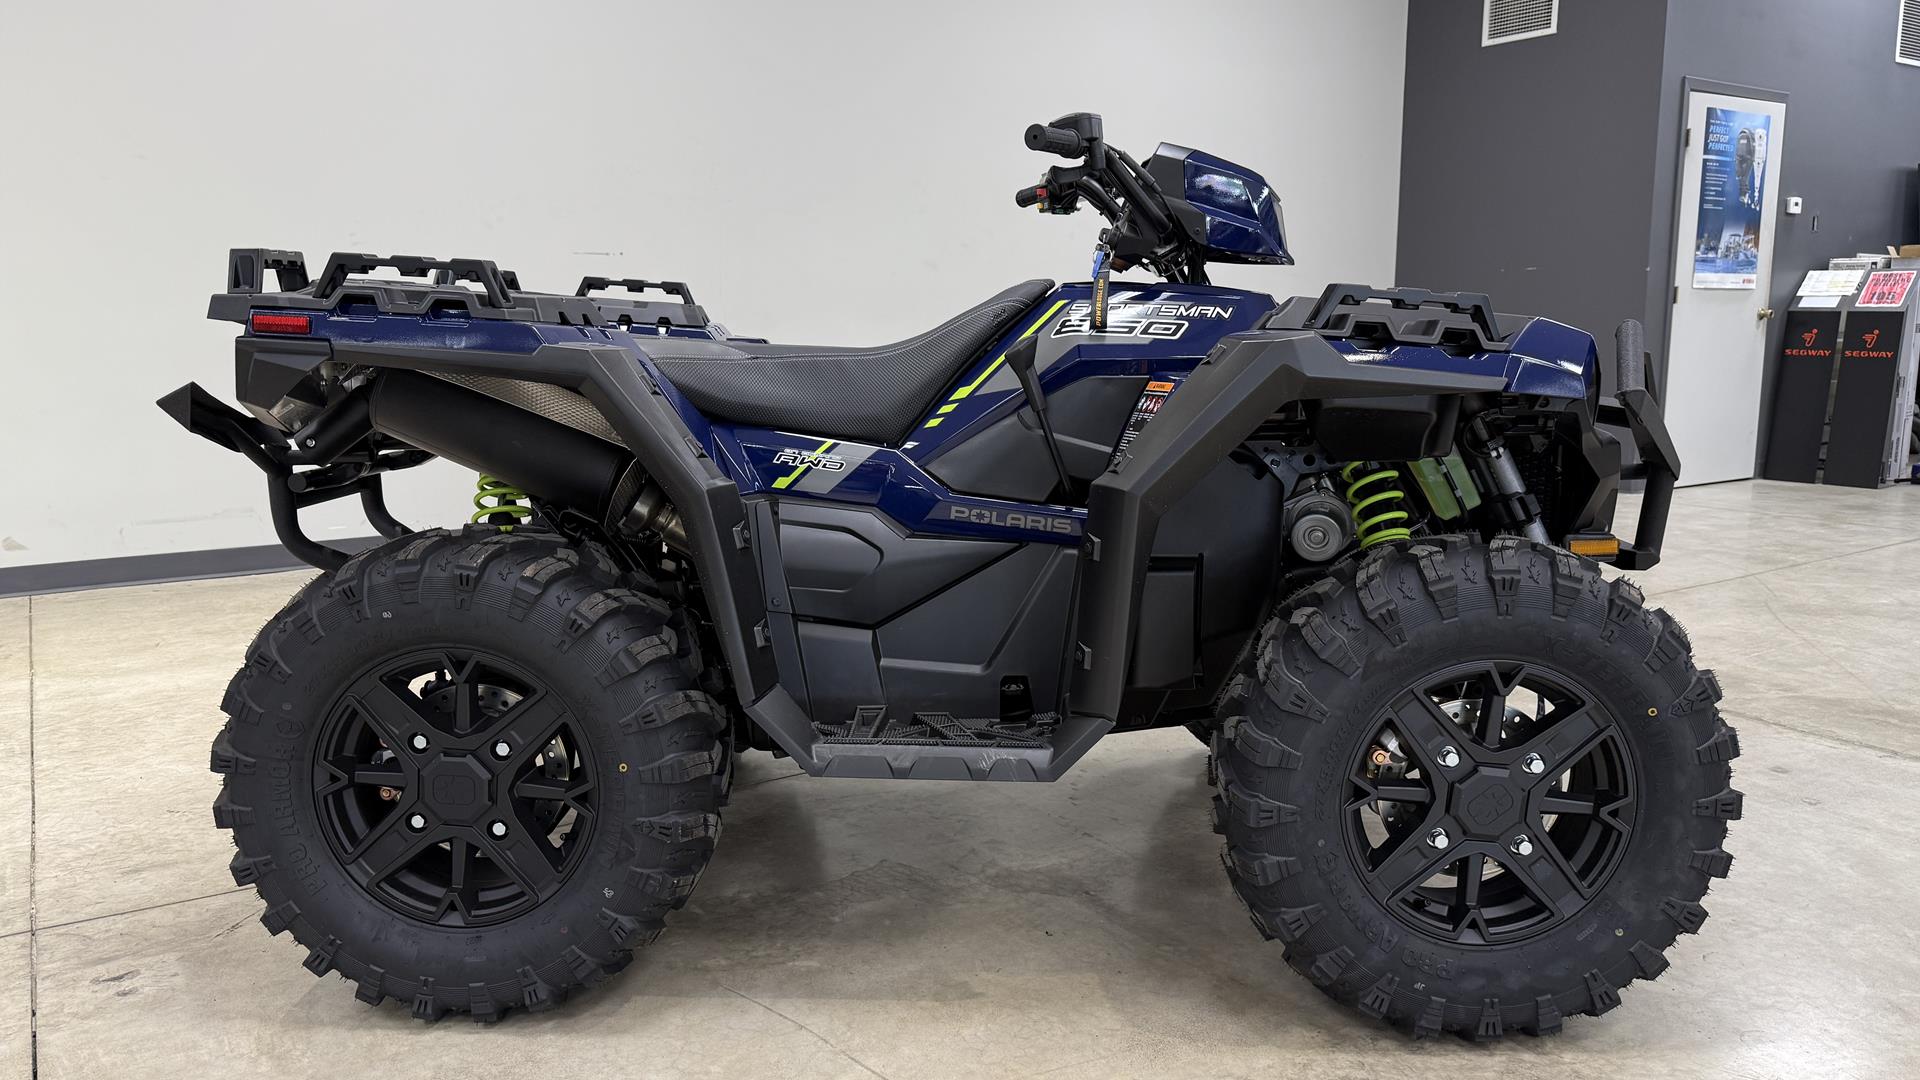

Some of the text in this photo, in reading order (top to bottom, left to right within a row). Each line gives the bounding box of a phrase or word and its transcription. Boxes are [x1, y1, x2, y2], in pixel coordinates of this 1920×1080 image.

[1709, 125, 1729, 134] PERFECT
[1707, 134, 1720, 143] JUST
[1051, 317, 1189, 339] 850
[1784, 348, 1832, 357] SEGWAY
[1844, 350, 1894, 359] SEGWAY
[772, 452, 846, 472] AWD
[950, 505, 1073, 534] POLARIS
[269, 739, 328, 897] PRO ARMOR
